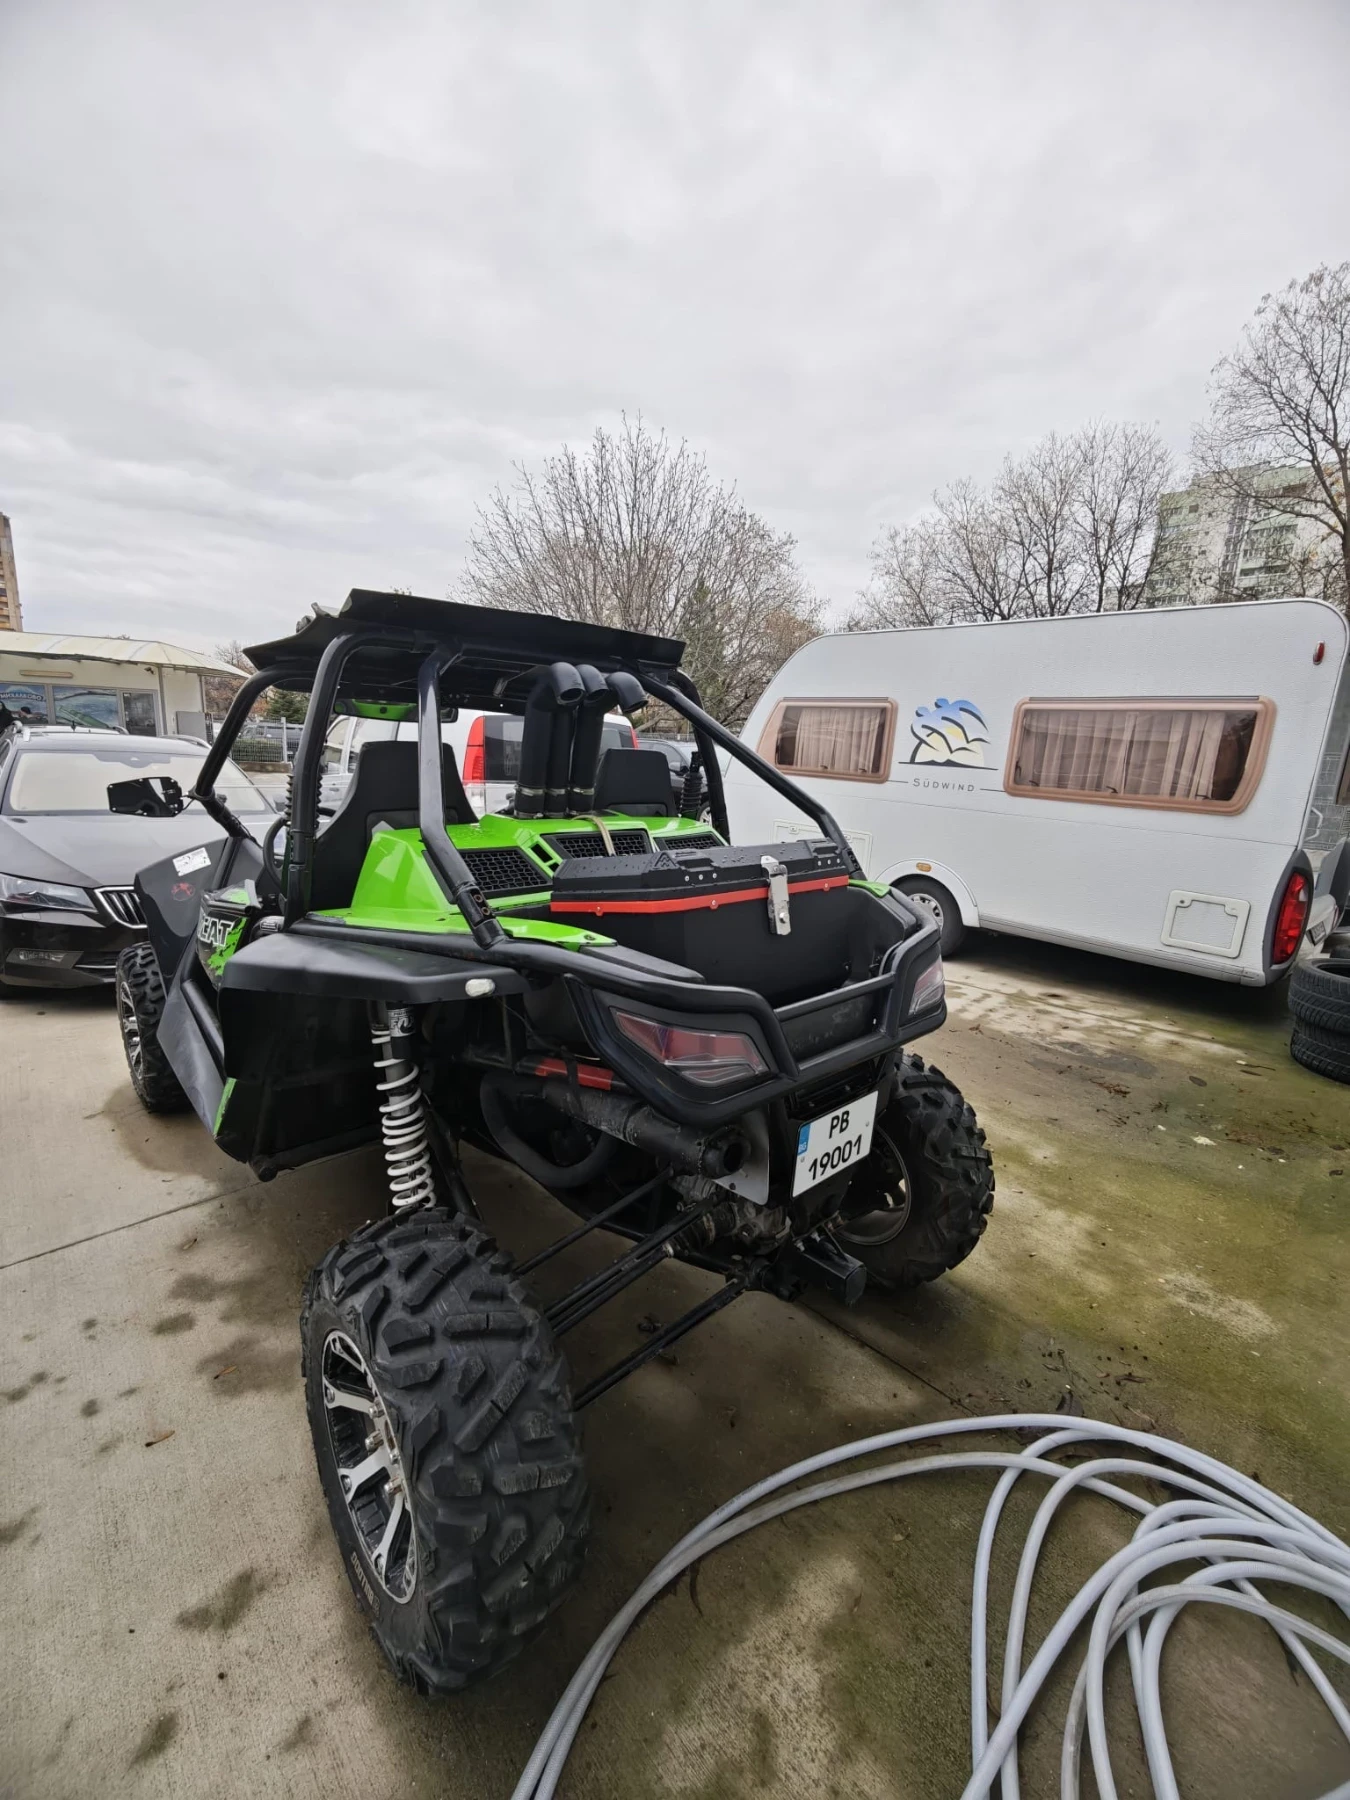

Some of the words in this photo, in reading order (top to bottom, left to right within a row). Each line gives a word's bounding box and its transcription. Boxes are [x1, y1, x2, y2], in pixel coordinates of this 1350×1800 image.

[912, 778, 975, 792] SÜDWIND
[828, 1110, 850, 1139] PB
[808, 1133, 863, 1181] 19001
